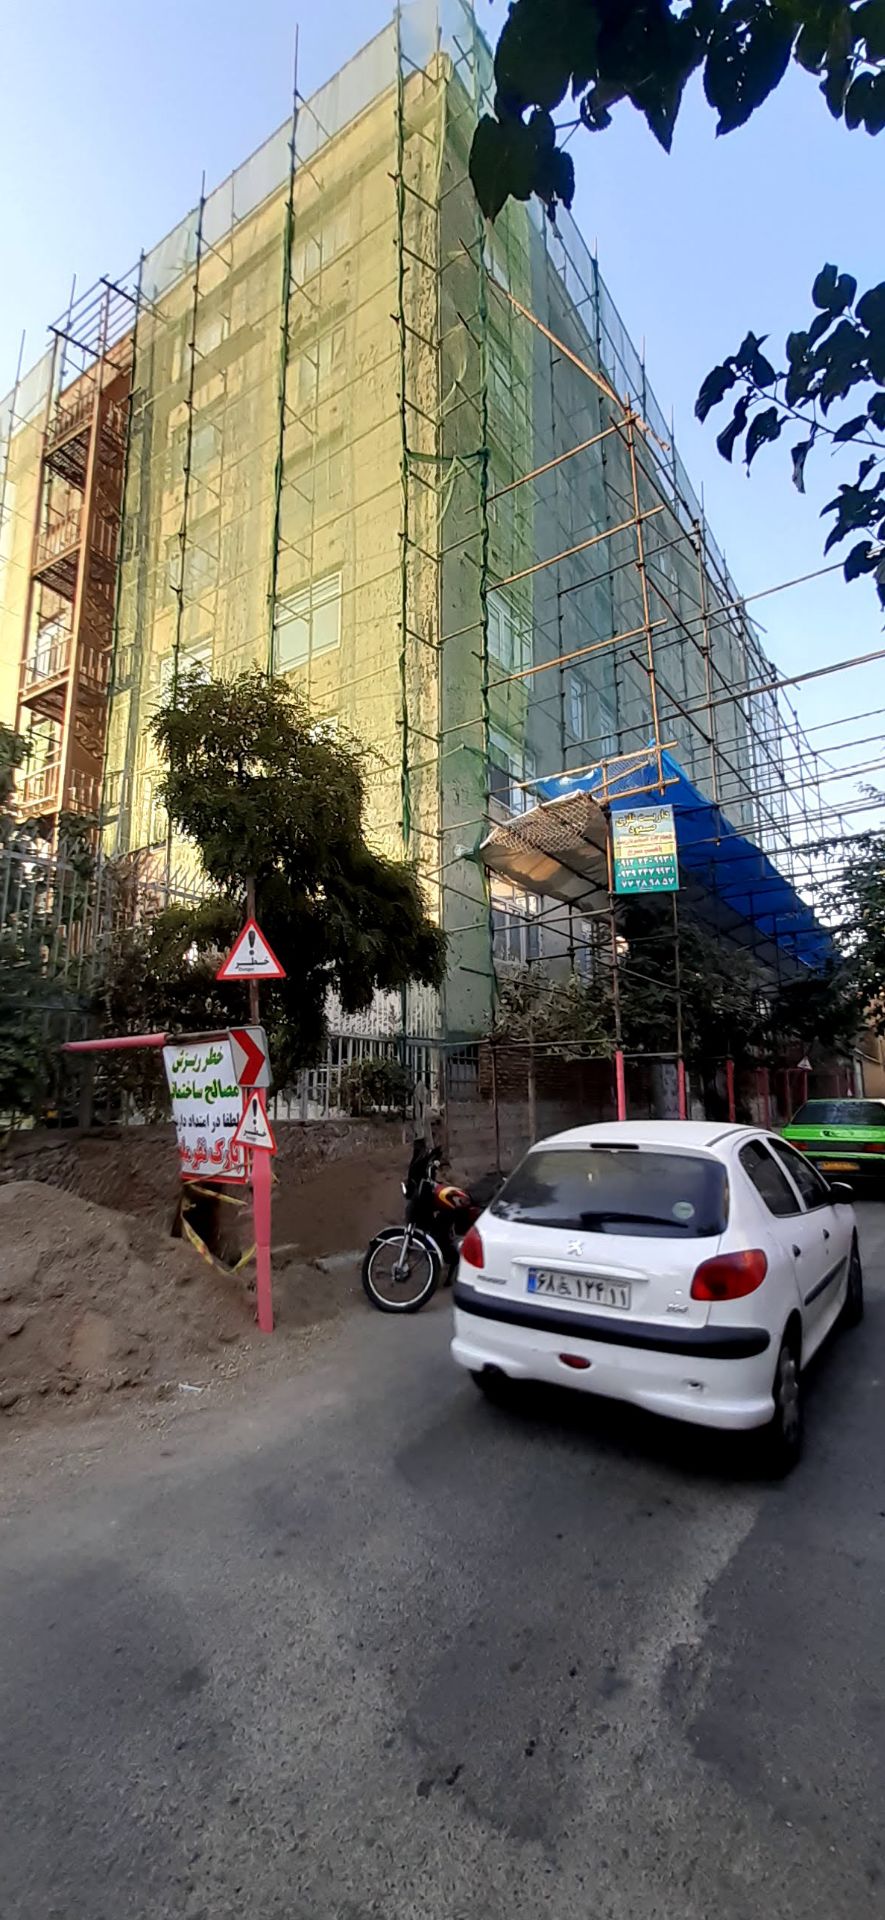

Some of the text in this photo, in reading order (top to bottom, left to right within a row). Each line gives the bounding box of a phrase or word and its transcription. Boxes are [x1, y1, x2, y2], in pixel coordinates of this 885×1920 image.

[234, 956, 269, 969] خطر
[172, 1046, 224, 1073] خطر ریزش
[204, 1078, 239, 1104] مصالح
[188, 1112, 210, 1128] امتداد
[211, 1114, 220, 1133] در
[222, 1112, 239, 1128] لطفا
[243, 1126, 267, 1137] خطر
[537, 1273, 555, 1292] ۶۸
[610, 1287, 626, 1306] ۱۱
